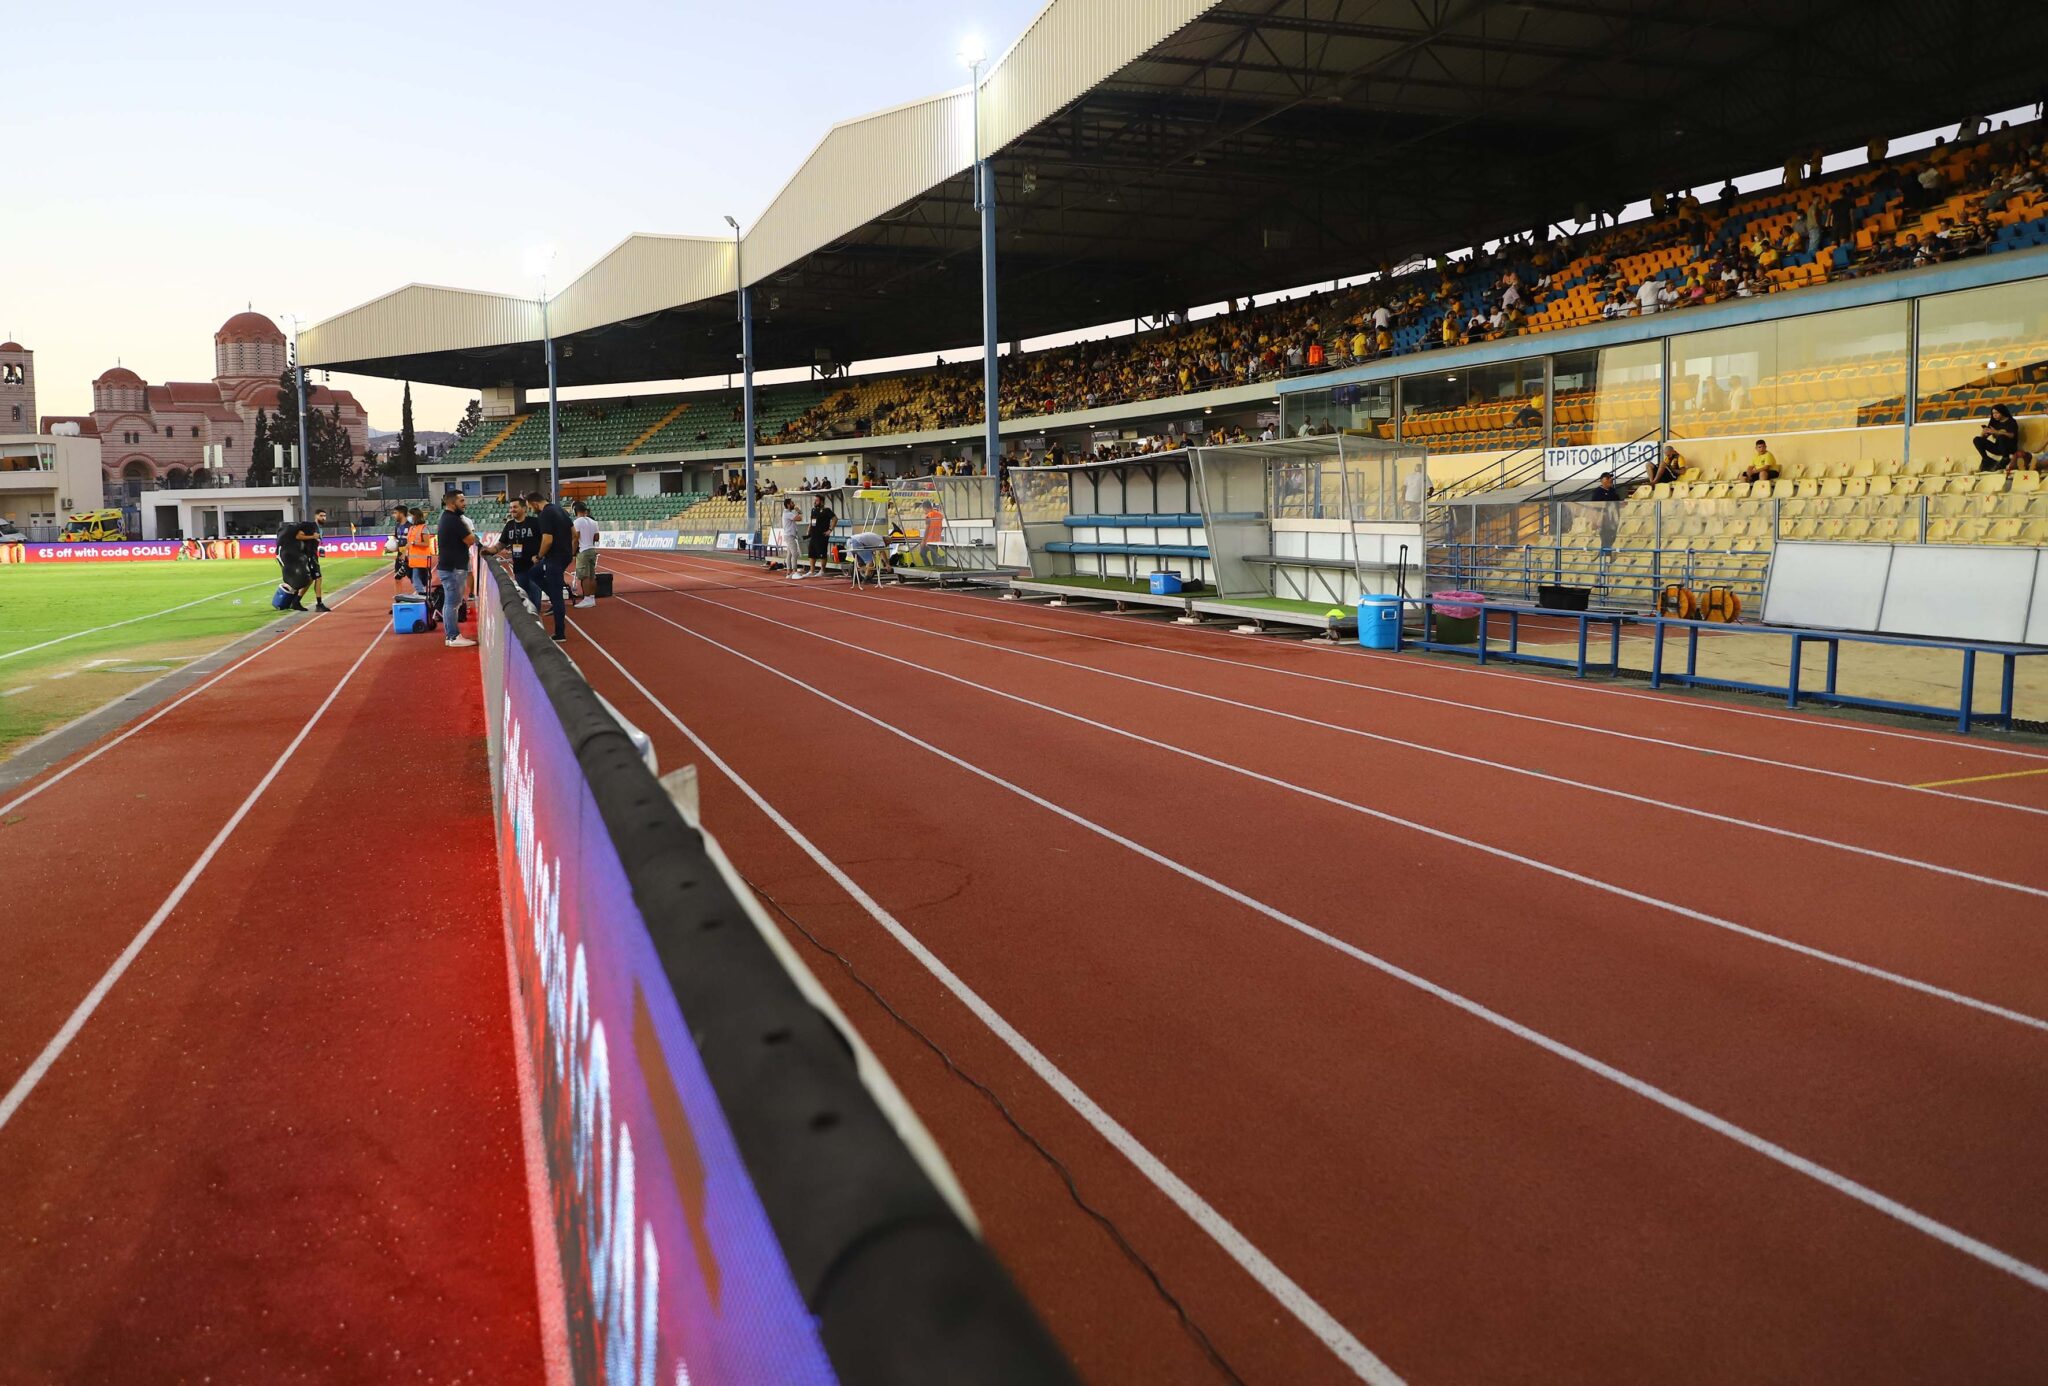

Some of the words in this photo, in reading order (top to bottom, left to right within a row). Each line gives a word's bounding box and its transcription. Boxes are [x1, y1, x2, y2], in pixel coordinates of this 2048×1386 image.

[634, 532, 674, 548] Stoiximan
[38, 548, 54, 558] €5
[56, 547, 72, 558] off
[74, 547, 98, 557] with
[101, 547, 129, 557] code
[131, 546, 171, 556] GOAL5
[252, 544, 267, 554] €5
[340, 541, 378, 552] GOAL5
[534, 841, 568, 1082] code
